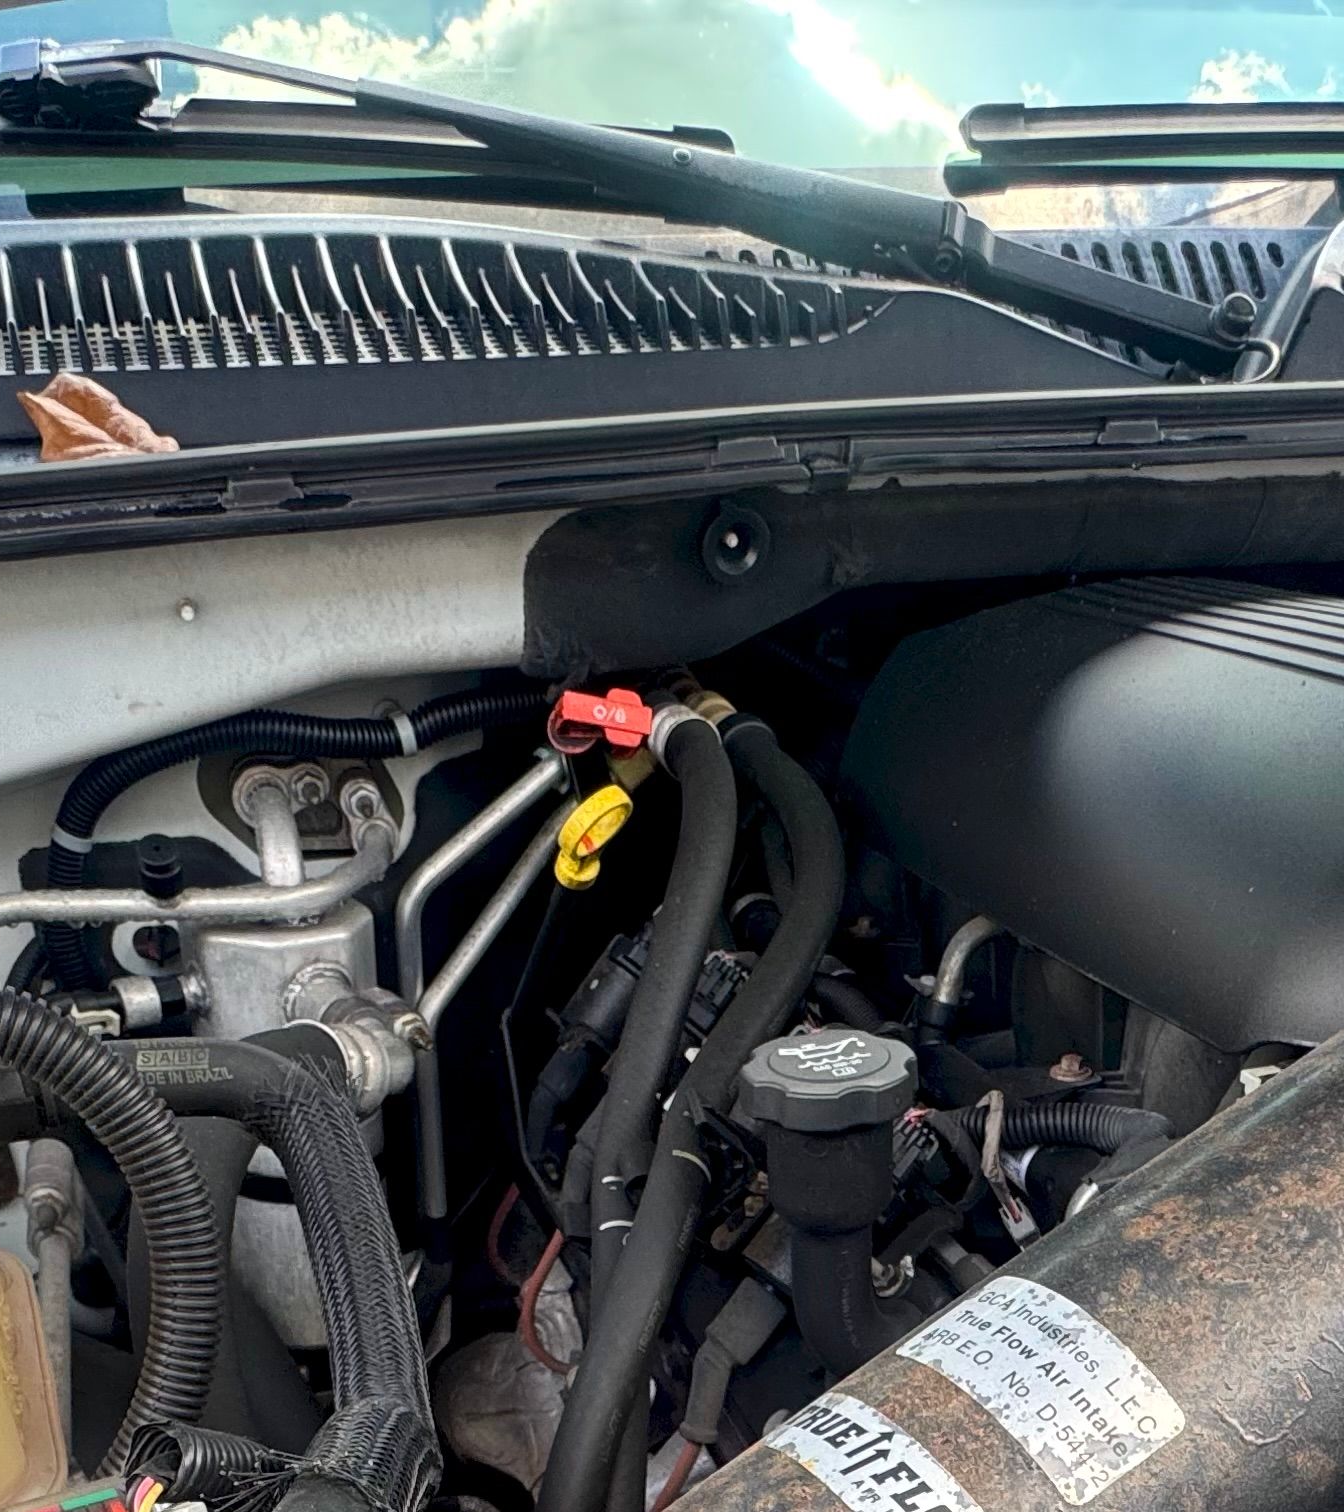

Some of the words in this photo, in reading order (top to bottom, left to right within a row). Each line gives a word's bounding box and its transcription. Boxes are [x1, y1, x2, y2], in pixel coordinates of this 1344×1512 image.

[138, 1048, 208, 1066] SABO
[169, 1071, 183, 1084] IN
[186, 1066, 234, 1084] BRAZIL
[977, 1290, 1016, 1312] GCA
[1011, 1303, 1099, 1380] Industries,
[956, 1309, 992, 1332] True
[991, 1325, 1039, 1361] Flow
[1036, 1360, 1071, 1388] Air
[1068, 1387, 1129, 1458] Intake
[791, 1405, 869, 1449] TRUE
[1036, 1402, 1111, 1490] D-544-2
